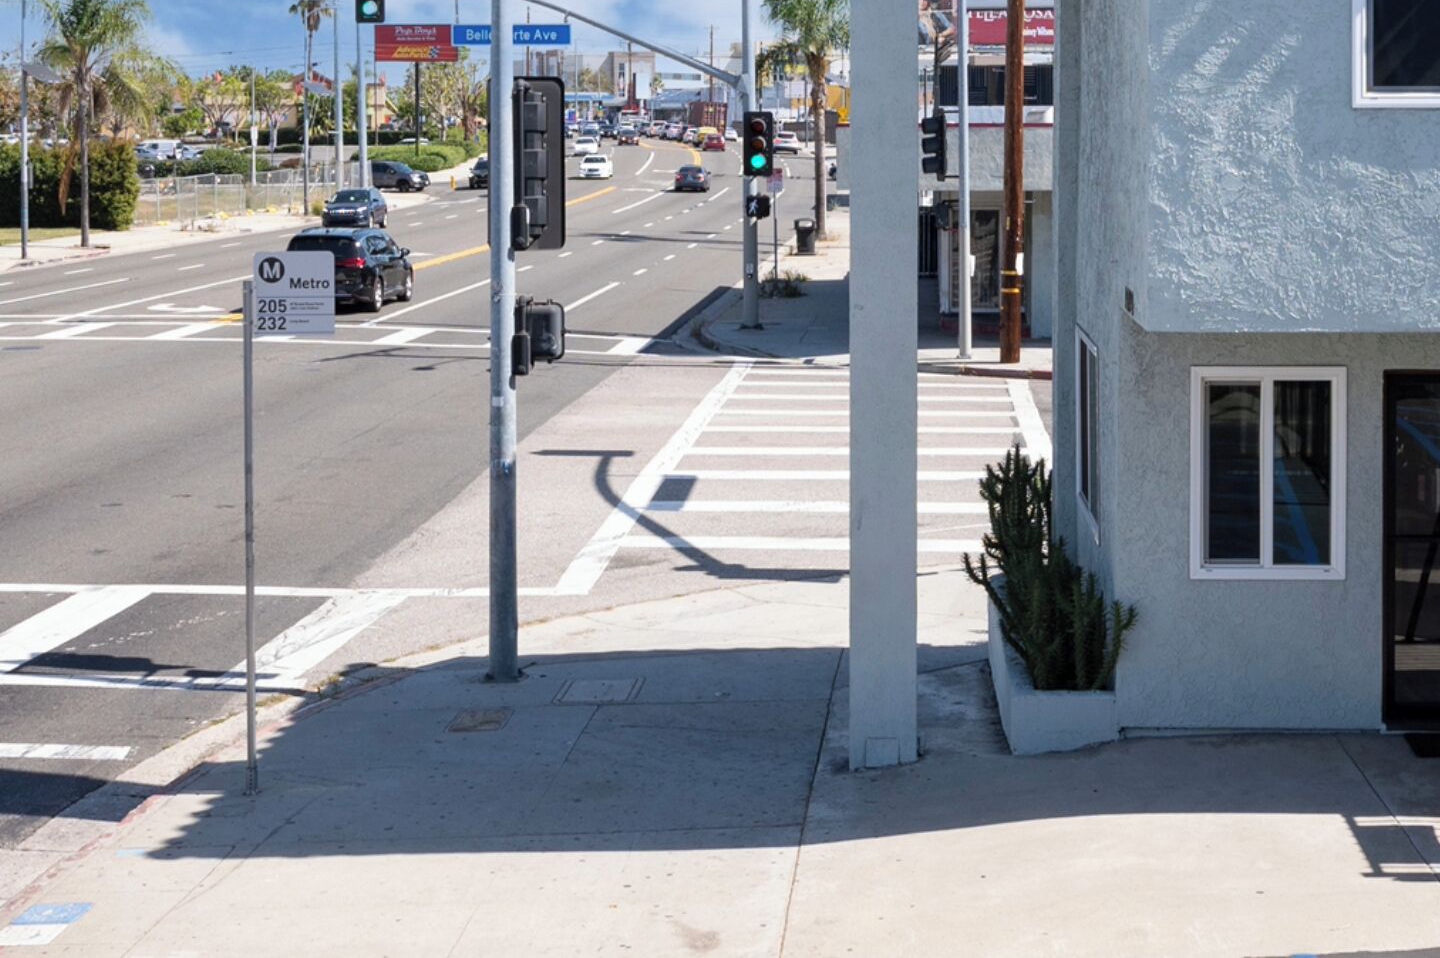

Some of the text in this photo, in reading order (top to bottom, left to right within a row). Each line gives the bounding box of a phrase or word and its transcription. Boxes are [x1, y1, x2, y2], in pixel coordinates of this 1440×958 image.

[534, 29, 557, 41] Ave
[289, 277, 331, 289] Metro
[258, 298, 288, 314] 205
[257, 315, 287, 331] 232
